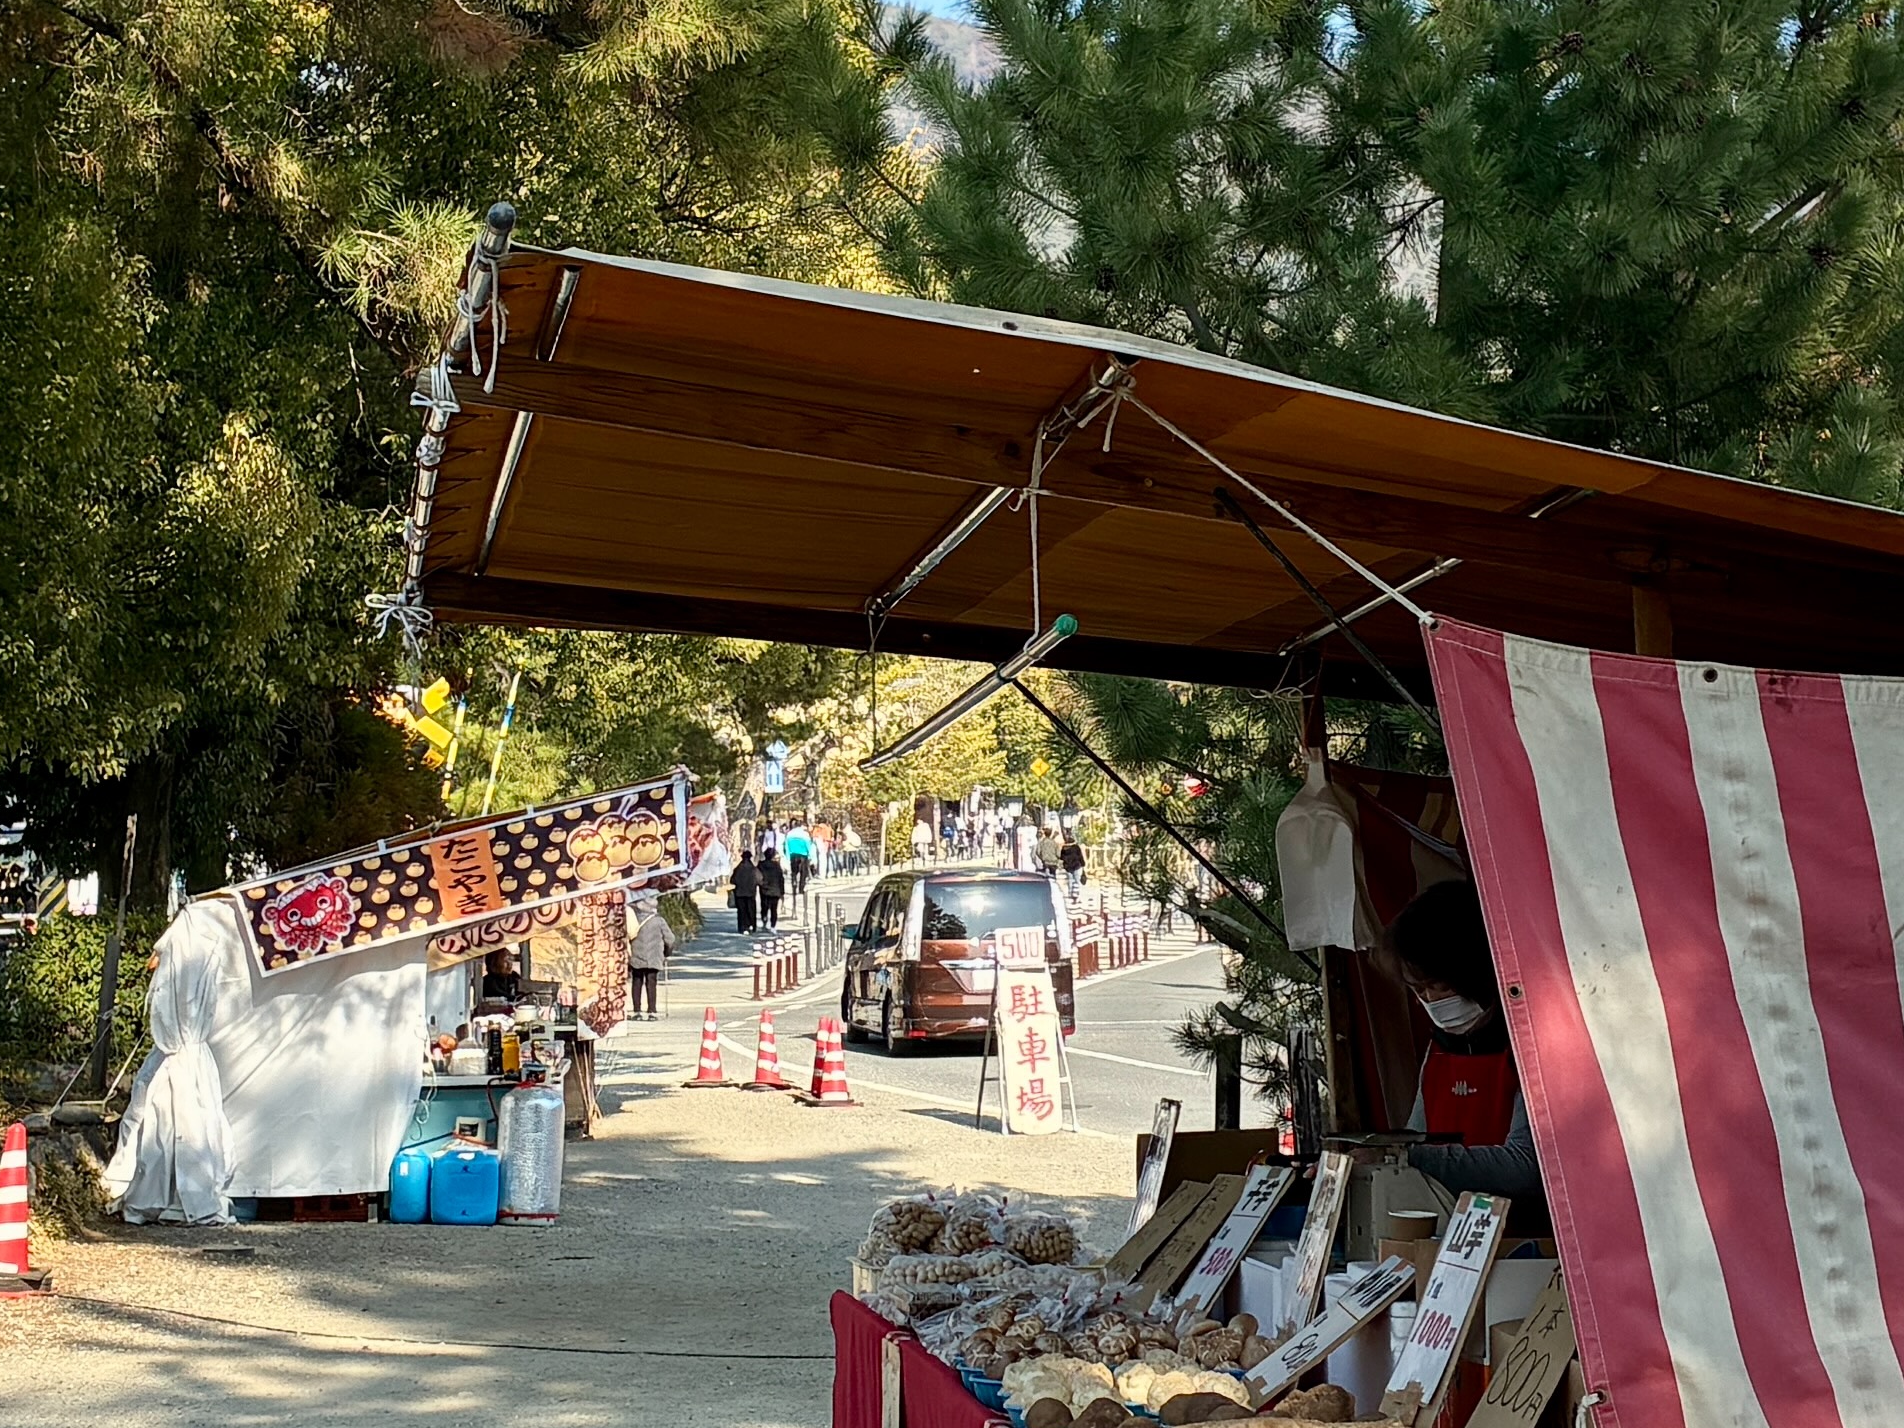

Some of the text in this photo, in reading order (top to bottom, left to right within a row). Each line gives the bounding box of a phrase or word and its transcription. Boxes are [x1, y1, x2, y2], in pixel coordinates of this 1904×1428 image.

[441, 838, 488, 915] たこやき
[1010, 984, 1054, 1121] 駐車場
[1446, 1210, 1491, 1260] 山芋
[1410, 1309, 1458, 1350] 1000円
[1486, 1336, 1551, 1421] 800円
